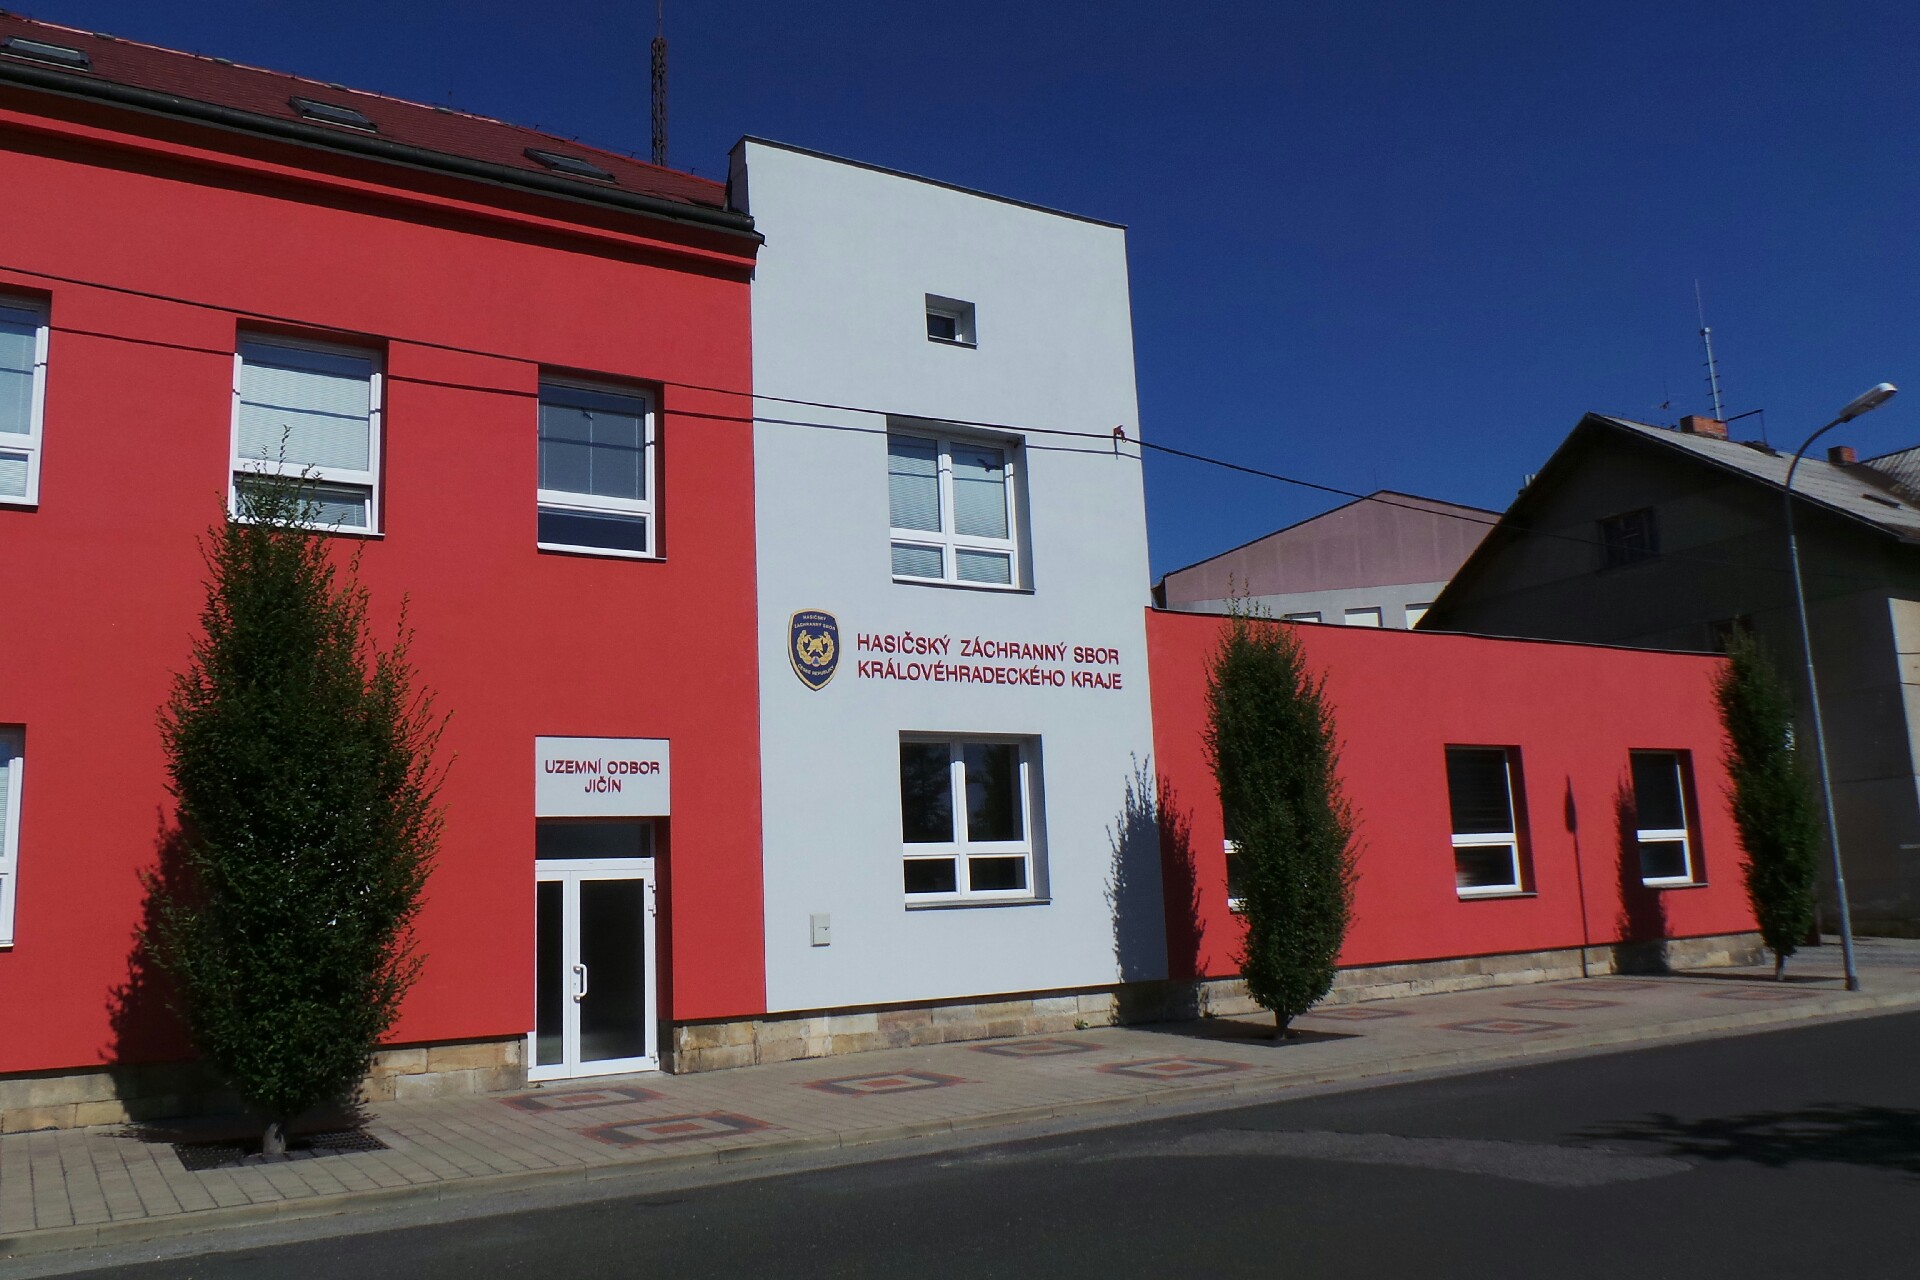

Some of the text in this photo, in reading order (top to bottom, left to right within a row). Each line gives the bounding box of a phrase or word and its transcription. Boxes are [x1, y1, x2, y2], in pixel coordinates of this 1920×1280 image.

[857, 630, 1119, 665] HASIČSKÝ ZÁCHRANNÝ SBOR
[857, 657, 1122, 690] KRÁLOVÉHRADECKÉHO KRAJE
[545, 757, 660, 775] UZEMNÍ ODBOR
[584, 775, 622, 793] JIČÍN
